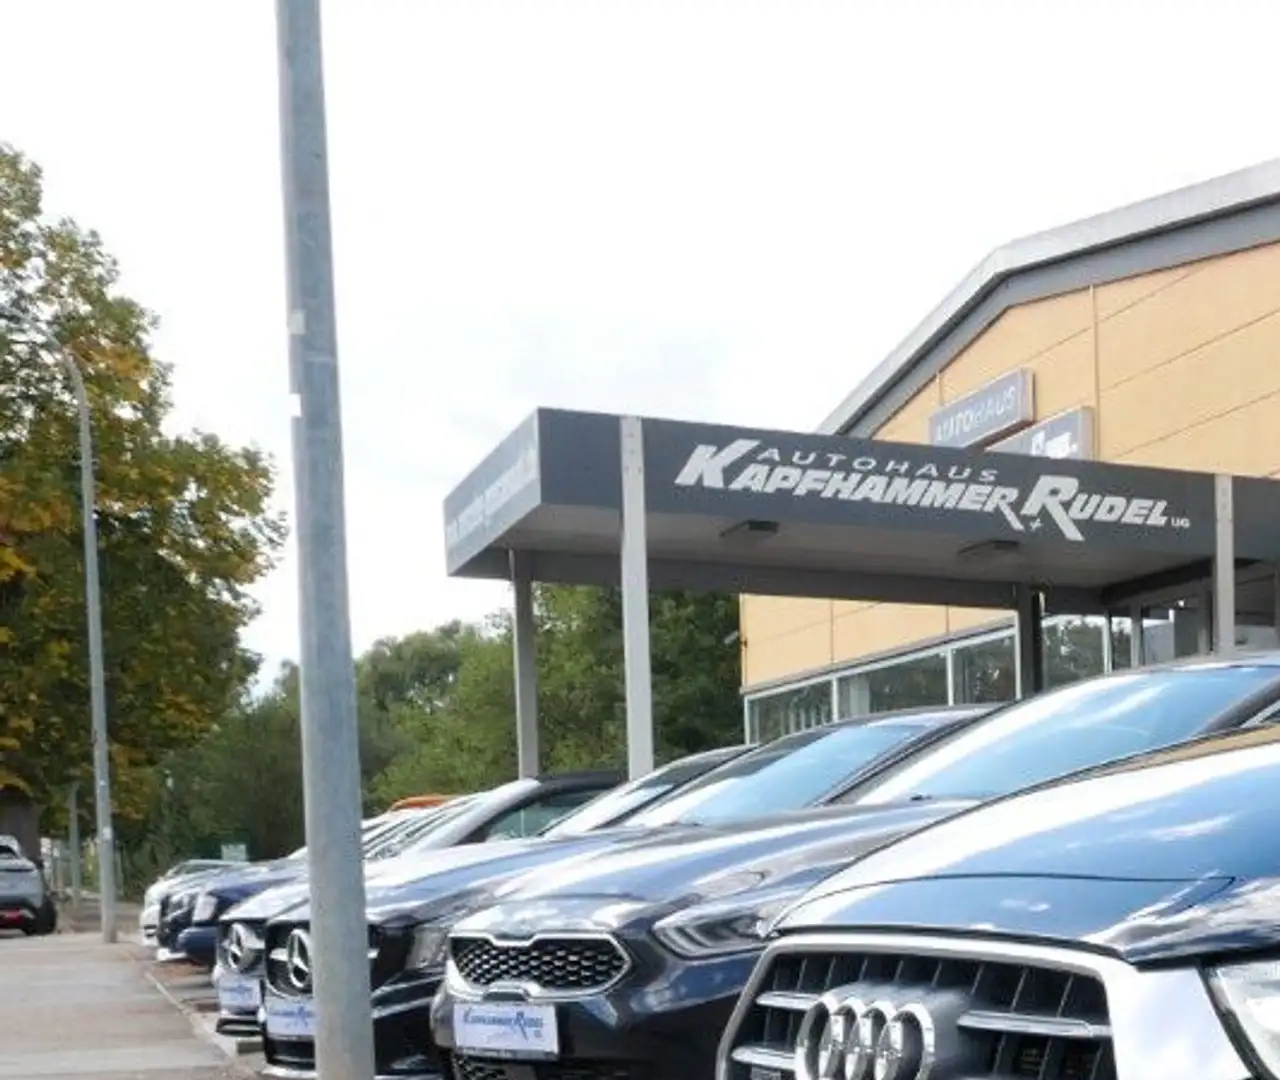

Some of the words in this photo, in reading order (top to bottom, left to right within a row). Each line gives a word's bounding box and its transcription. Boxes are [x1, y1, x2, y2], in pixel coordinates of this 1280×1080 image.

[674, 438, 1025, 532] KAPFHAMMER
[1019, 474, 1168, 542] RUDEL
[1171, 517, 1191, 529] UG
[756, 447, 998, 482] AUTOHAUS
